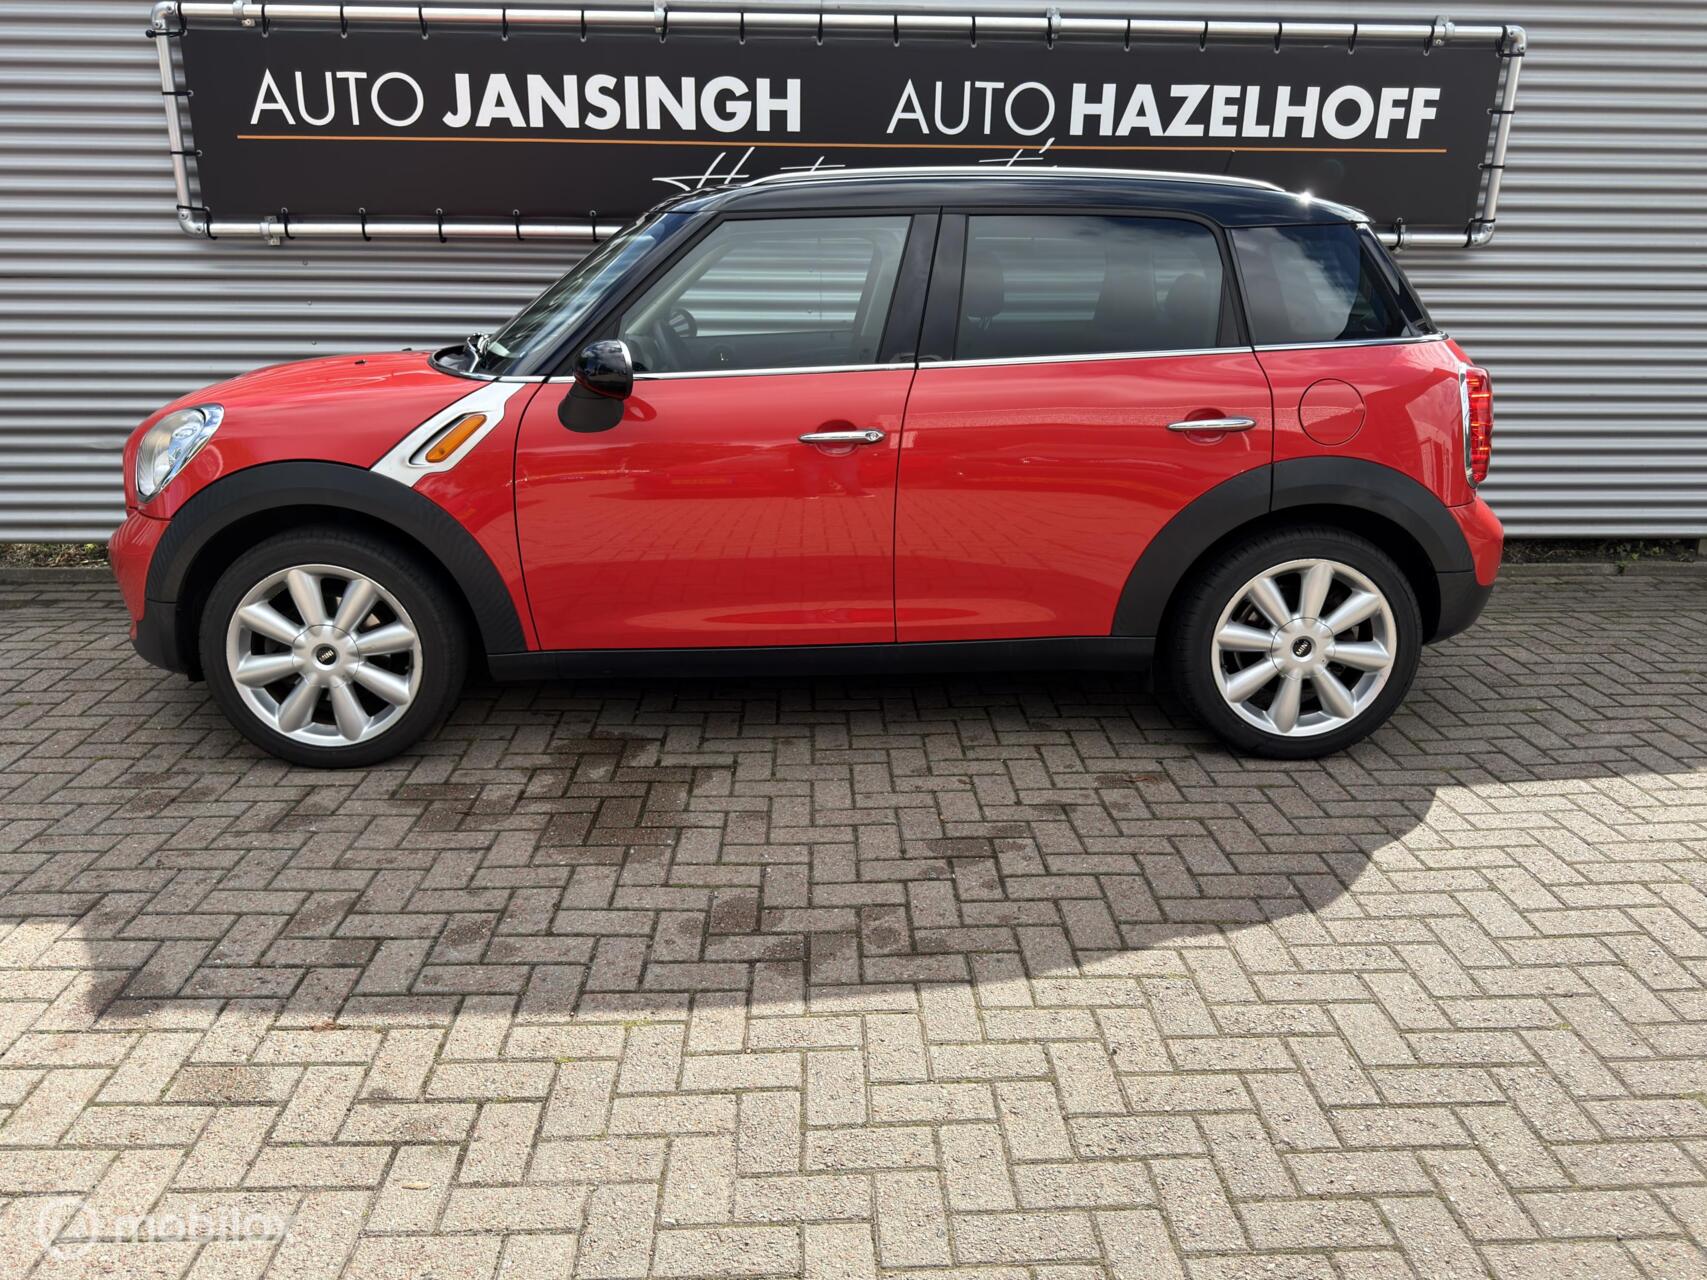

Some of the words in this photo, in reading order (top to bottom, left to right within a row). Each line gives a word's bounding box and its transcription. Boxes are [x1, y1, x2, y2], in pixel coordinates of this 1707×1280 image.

[250, 68, 424, 126] AUTO
[442, 73, 801, 133] JANSINGH
[886, 78, 1056, 136] AUTO
[1069, 83, 1441, 139] HAZELHOFF
